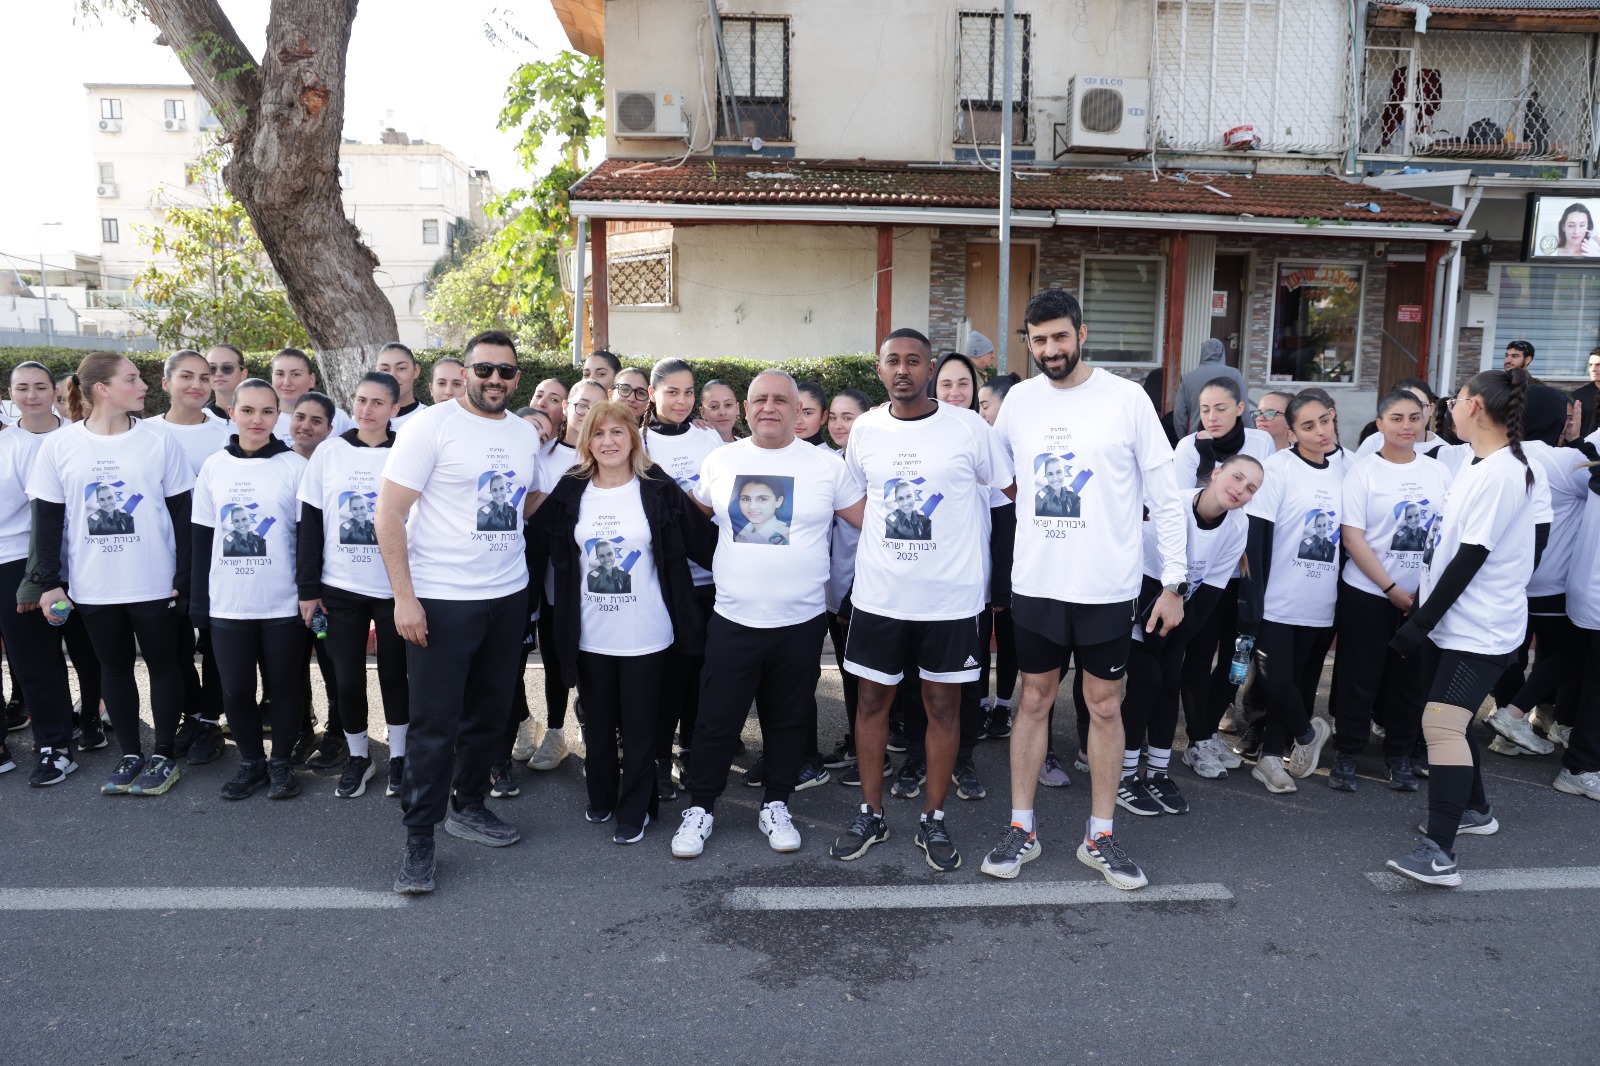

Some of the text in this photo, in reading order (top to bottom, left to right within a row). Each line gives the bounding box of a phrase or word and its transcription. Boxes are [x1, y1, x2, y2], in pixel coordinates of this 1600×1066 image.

[1099, 78, 1123, 86] ELCO
[1056, 519, 1086, 529] גיבורת
[470, 530, 497, 542] ישראל
[1045, 529, 1067, 539] 2025
[84, 535, 141, 545] גיבורת ישראל
[882, 537, 937, 551] גיבורת ישראל
[102, 544, 124, 553] 2025
[336, 544, 381, 554] בורת ישראל
[489, 542, 508, 552] 2025
[351, 555, 372, 563] 2025
[896, 551, 919, 561] 2025
[1385, 551, 1408, 560] ישראל
[218, 558, 272, 566] גיבורת ישראל
[1292, 558, 1315, 569] ישראל
[1400, 560, 1420, 569] 2025
[235, 567, 255, 575] 2025
[1306, 569, 1322, 579] 2025
[583, 591, 637, 604] גיבורת ישראל
[598, 603, 619, 612] 2024
